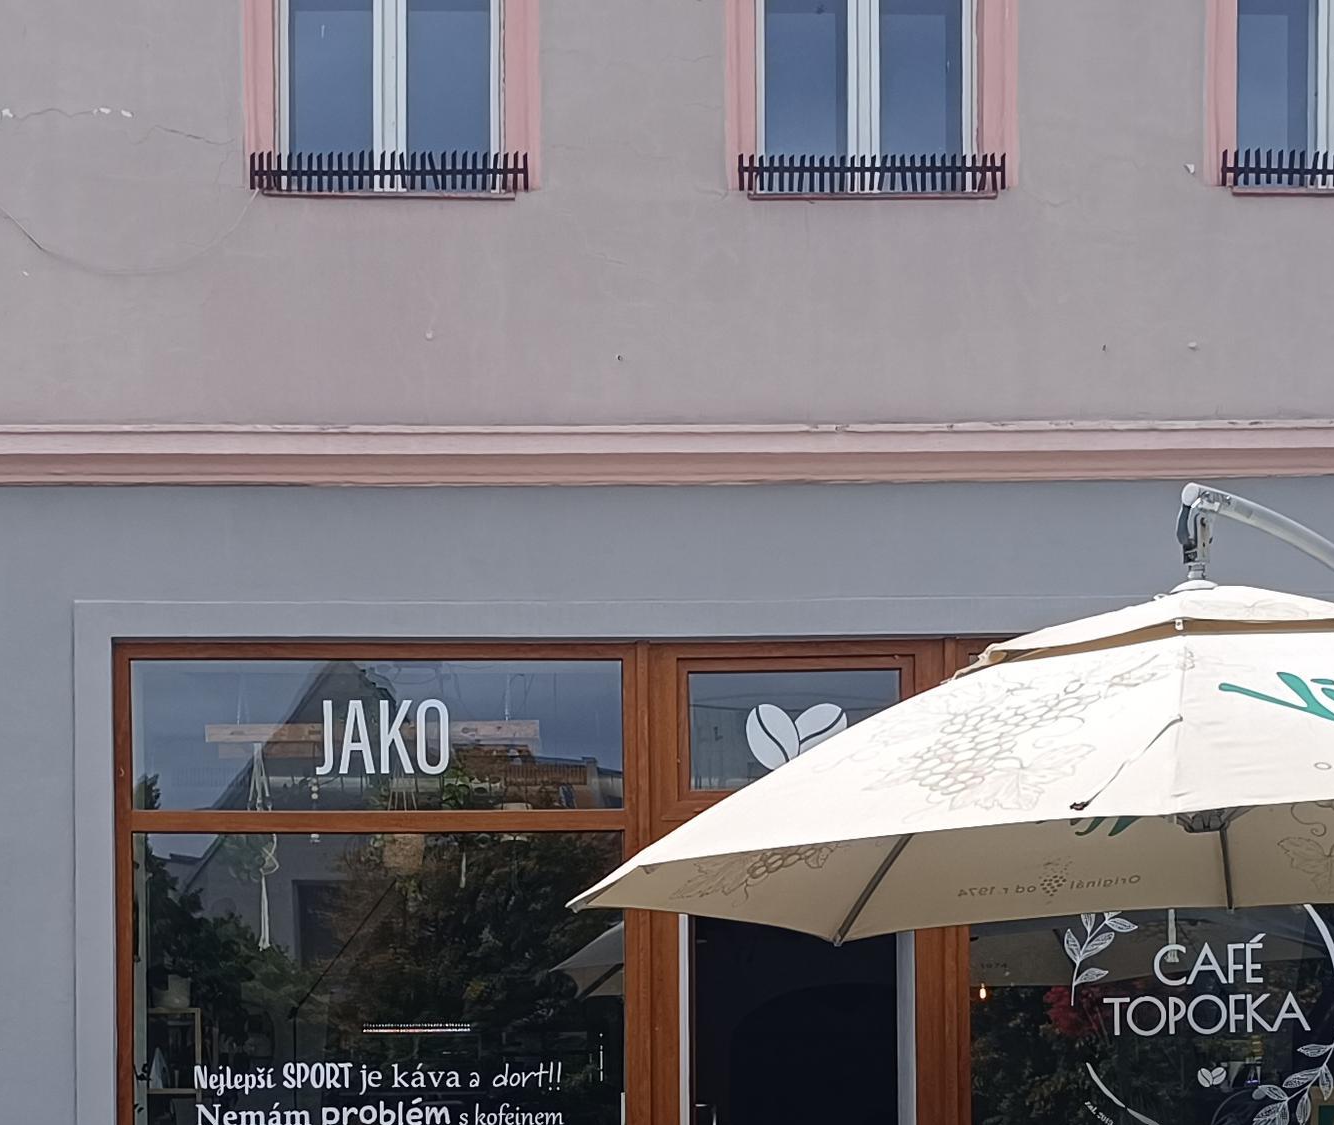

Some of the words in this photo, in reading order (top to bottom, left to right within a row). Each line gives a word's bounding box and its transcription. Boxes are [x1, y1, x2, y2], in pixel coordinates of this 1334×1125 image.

[315, 698, 450, 775] JAKO
[1153, 933, 1265, 985] CAFÉ
[1102, 991, 1311, 1036] TOPOFKA
[193, 1064, 277, 1096] Nejlepší
[282, 1062, 353, 1089] SPORT
[359, 1064, 382, 1095] je
[391, 1063, 461, 1088] káva
[469, 1072, 480, 1088] a
[492, 1061, 562, 1091] dort!!
[459, 1113, 469, 1125] s
